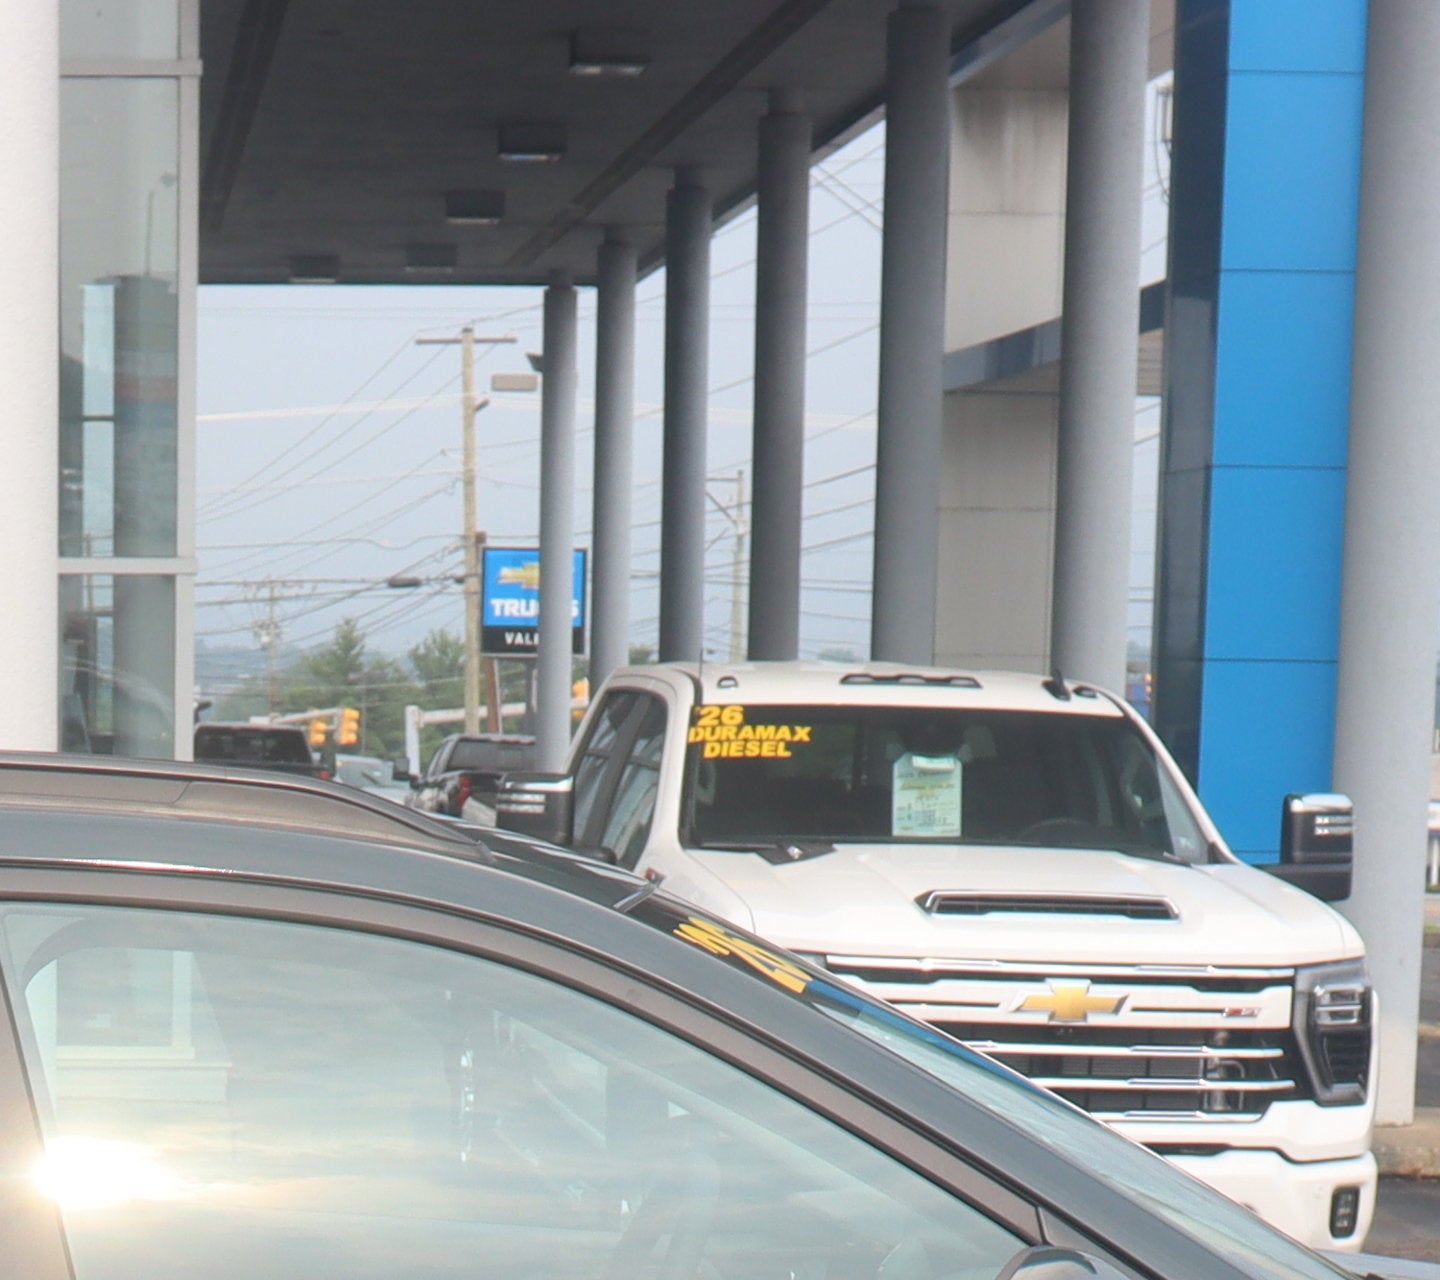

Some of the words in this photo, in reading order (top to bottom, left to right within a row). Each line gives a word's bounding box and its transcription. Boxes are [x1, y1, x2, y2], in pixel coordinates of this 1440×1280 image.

[490, 598, 580, 618] TRUS
[687, 725, 812, 743] DURAMAX
[703, 740, 792, 759] DIESEL
